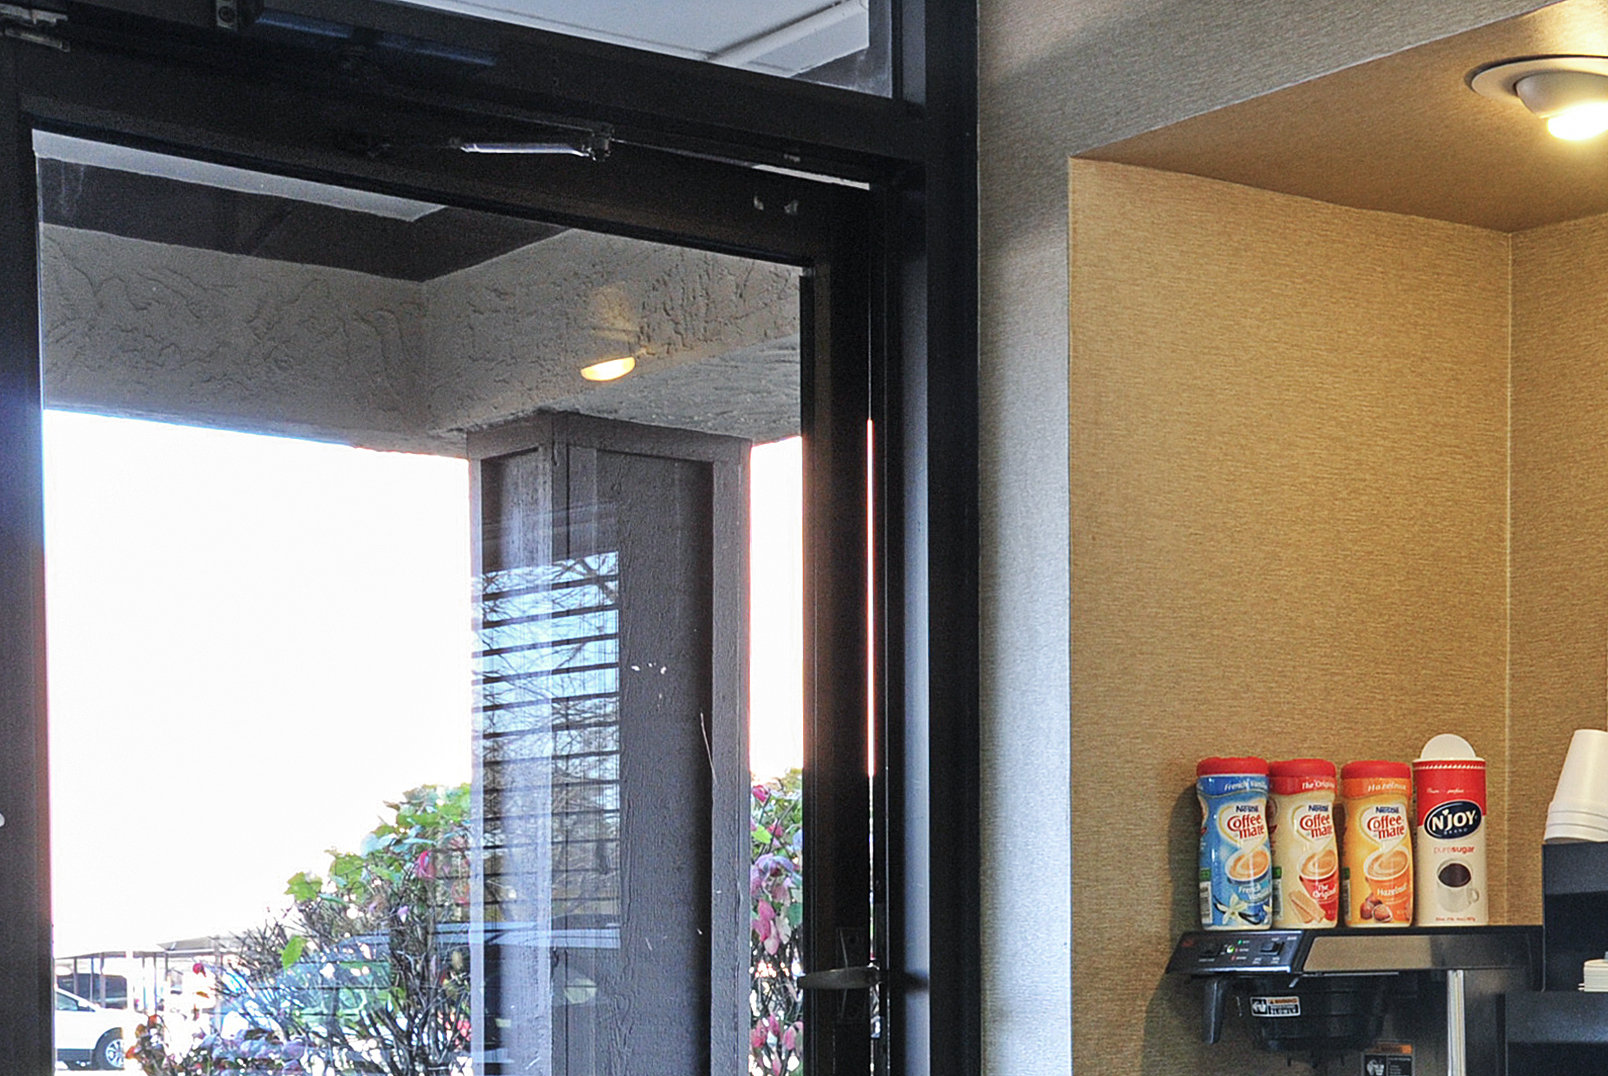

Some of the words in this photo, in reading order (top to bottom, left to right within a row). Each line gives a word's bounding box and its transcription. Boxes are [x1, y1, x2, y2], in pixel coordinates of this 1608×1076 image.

[1227, 813, 1262, 832] Coffee
[1299, 813, 1331, 831] Coffee
[1367, 814, 1402, 833] Coffee
[1378, 825, 1405, 839] mate
